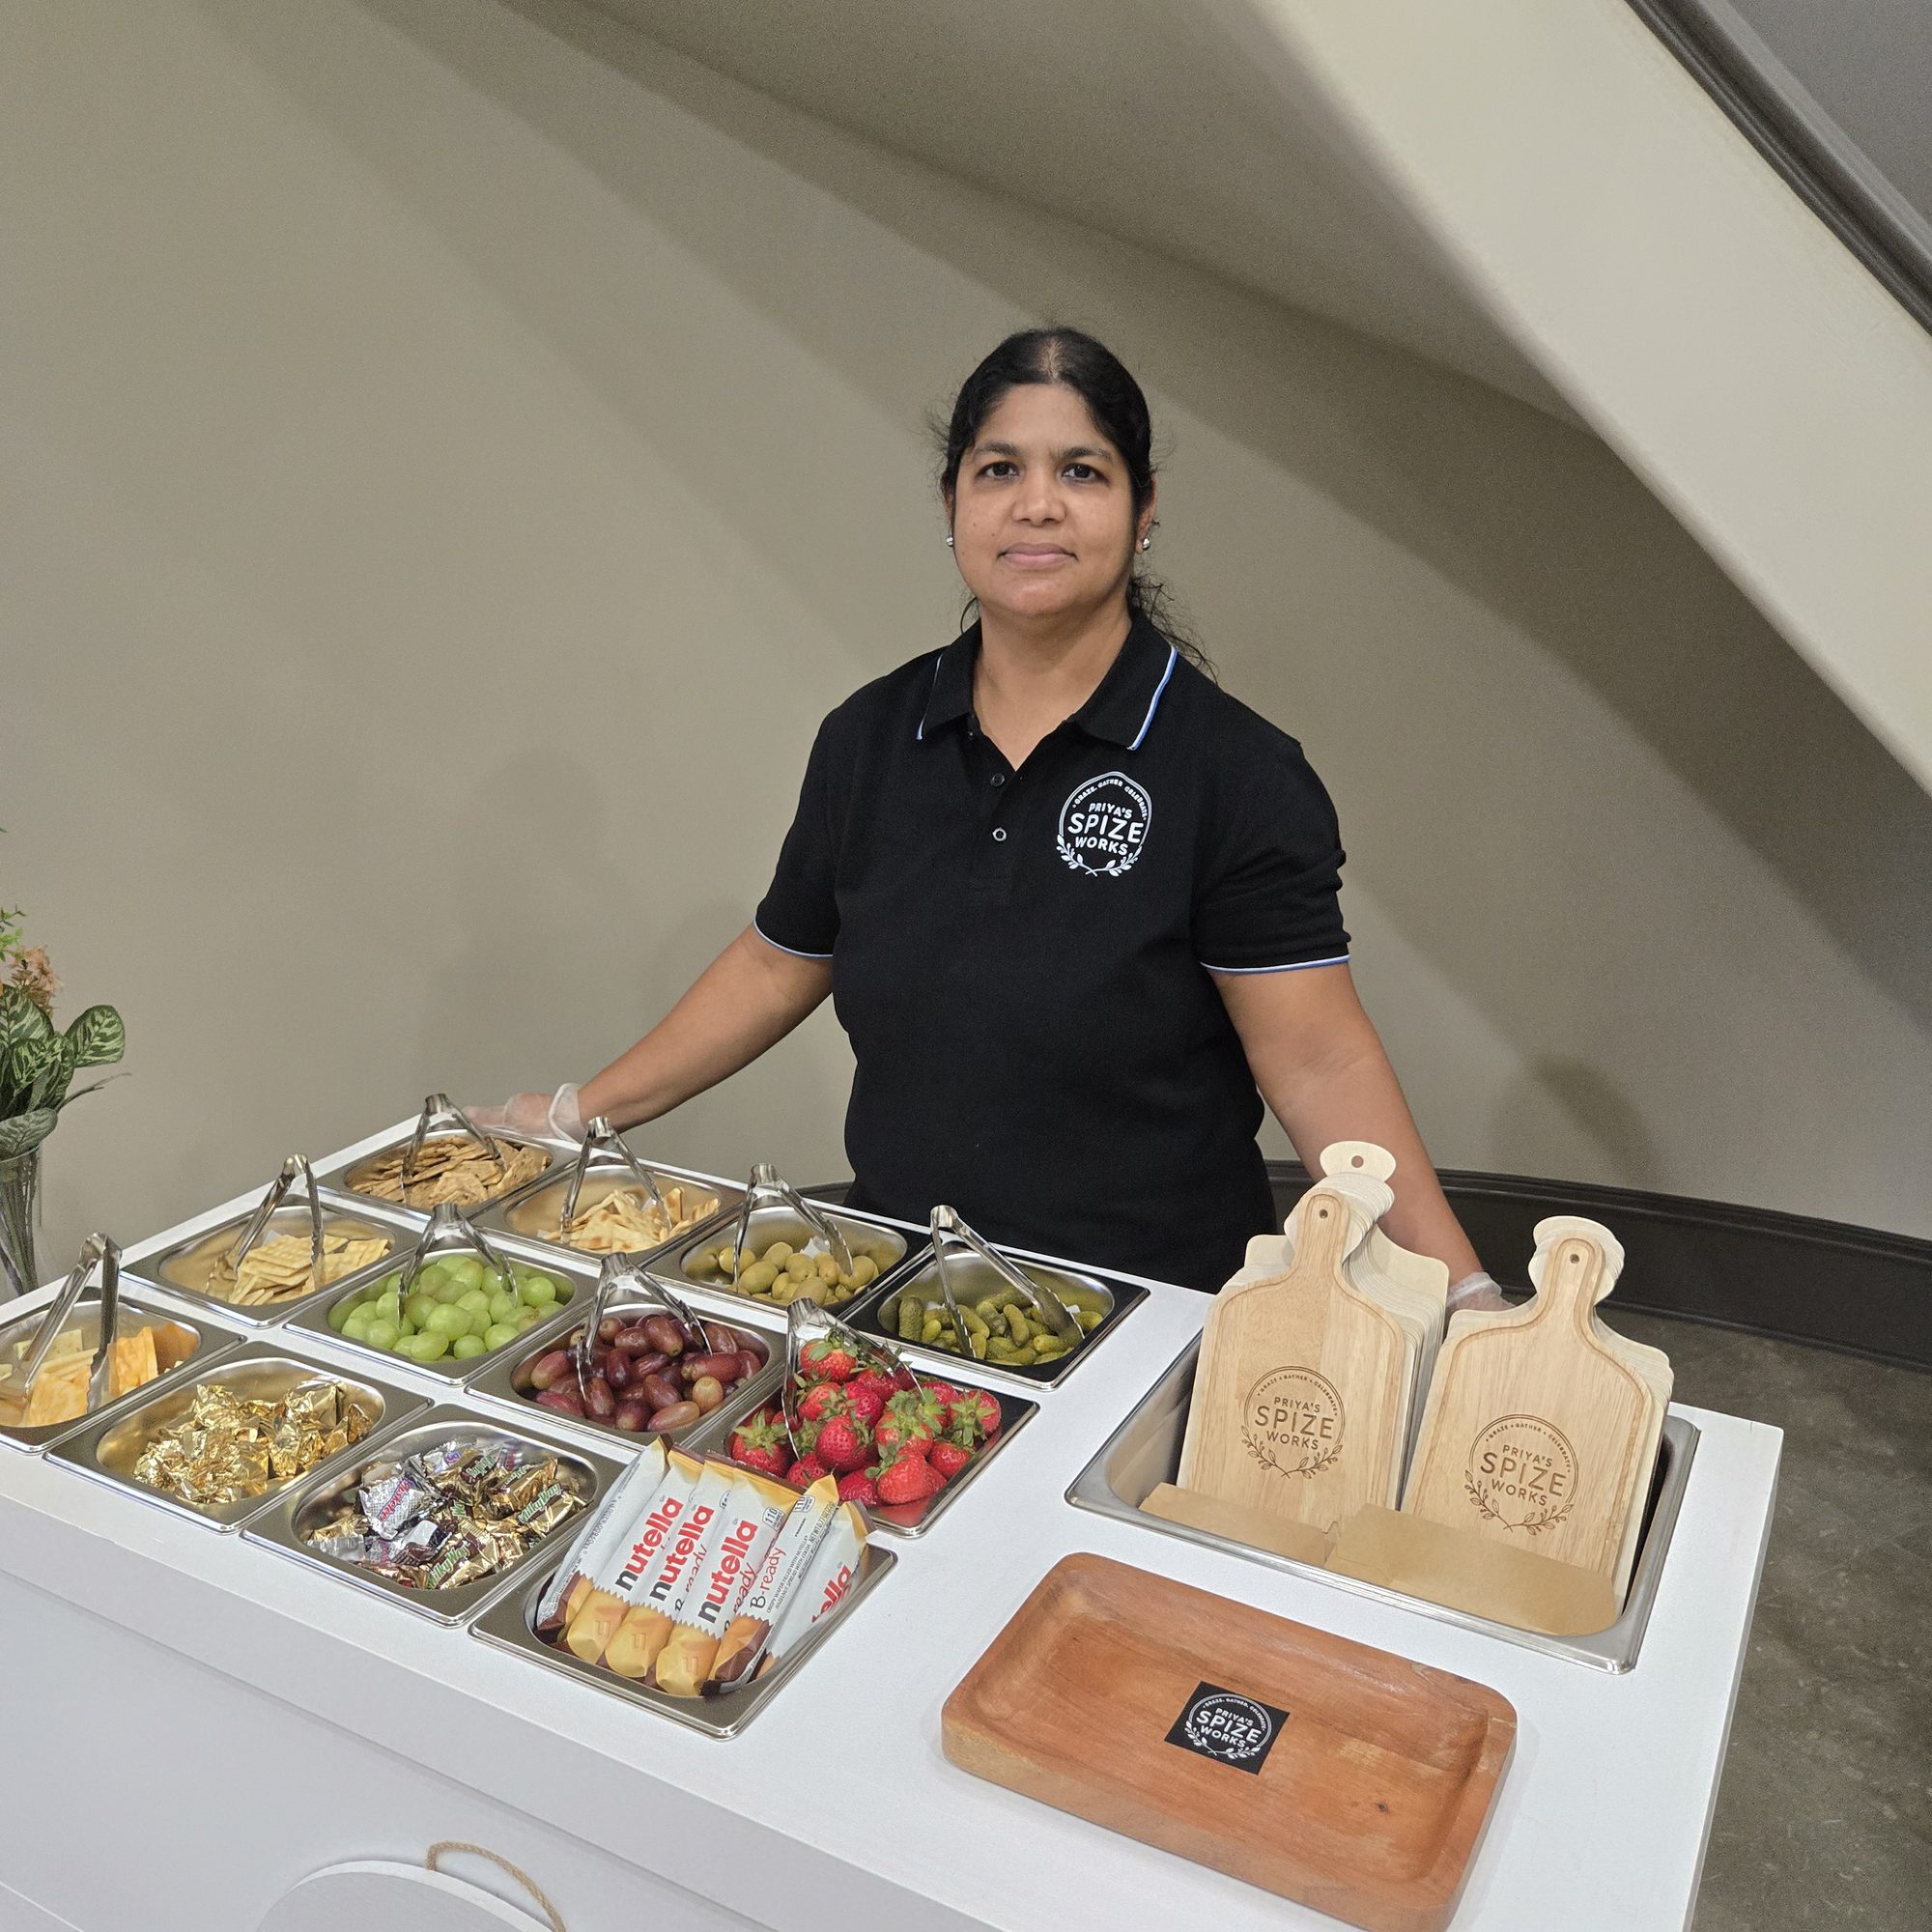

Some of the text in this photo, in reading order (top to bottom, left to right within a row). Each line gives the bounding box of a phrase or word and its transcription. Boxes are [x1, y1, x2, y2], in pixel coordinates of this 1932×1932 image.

[1089, 802, 1133, 819] PRIYA'S
[1067, 812, 1144, 843] SPIZE
[1075, 836, 1128, 856] WORKS
[1273, 1396, 1321, 1413] PRIYA'S
[1255, 1406, 1334, 1439] SPIZE
[1266, 1431, 1320, 1450] WORKS
[1502, 1444, 1553, 1467] PRIYA'S
[1480, 1451, 1567, 1497] SPIZE
[1492, 1478, 1548, 1506] WORKS
[764, 1507, 779, 1523] 110
[614, 1497, 685, 1592] nutella
[649, 1505, 715, 1602] nutella
[697, 1520, 758, 1624] nutella
[750, 1547, 787, 1608] B-ready
[1196, 1710, 1262, 1744] SPIZE
[1215, 1707, 1254, 1727] PRIYA'S
[1200, 1724, 1246, 1747] WORKS
